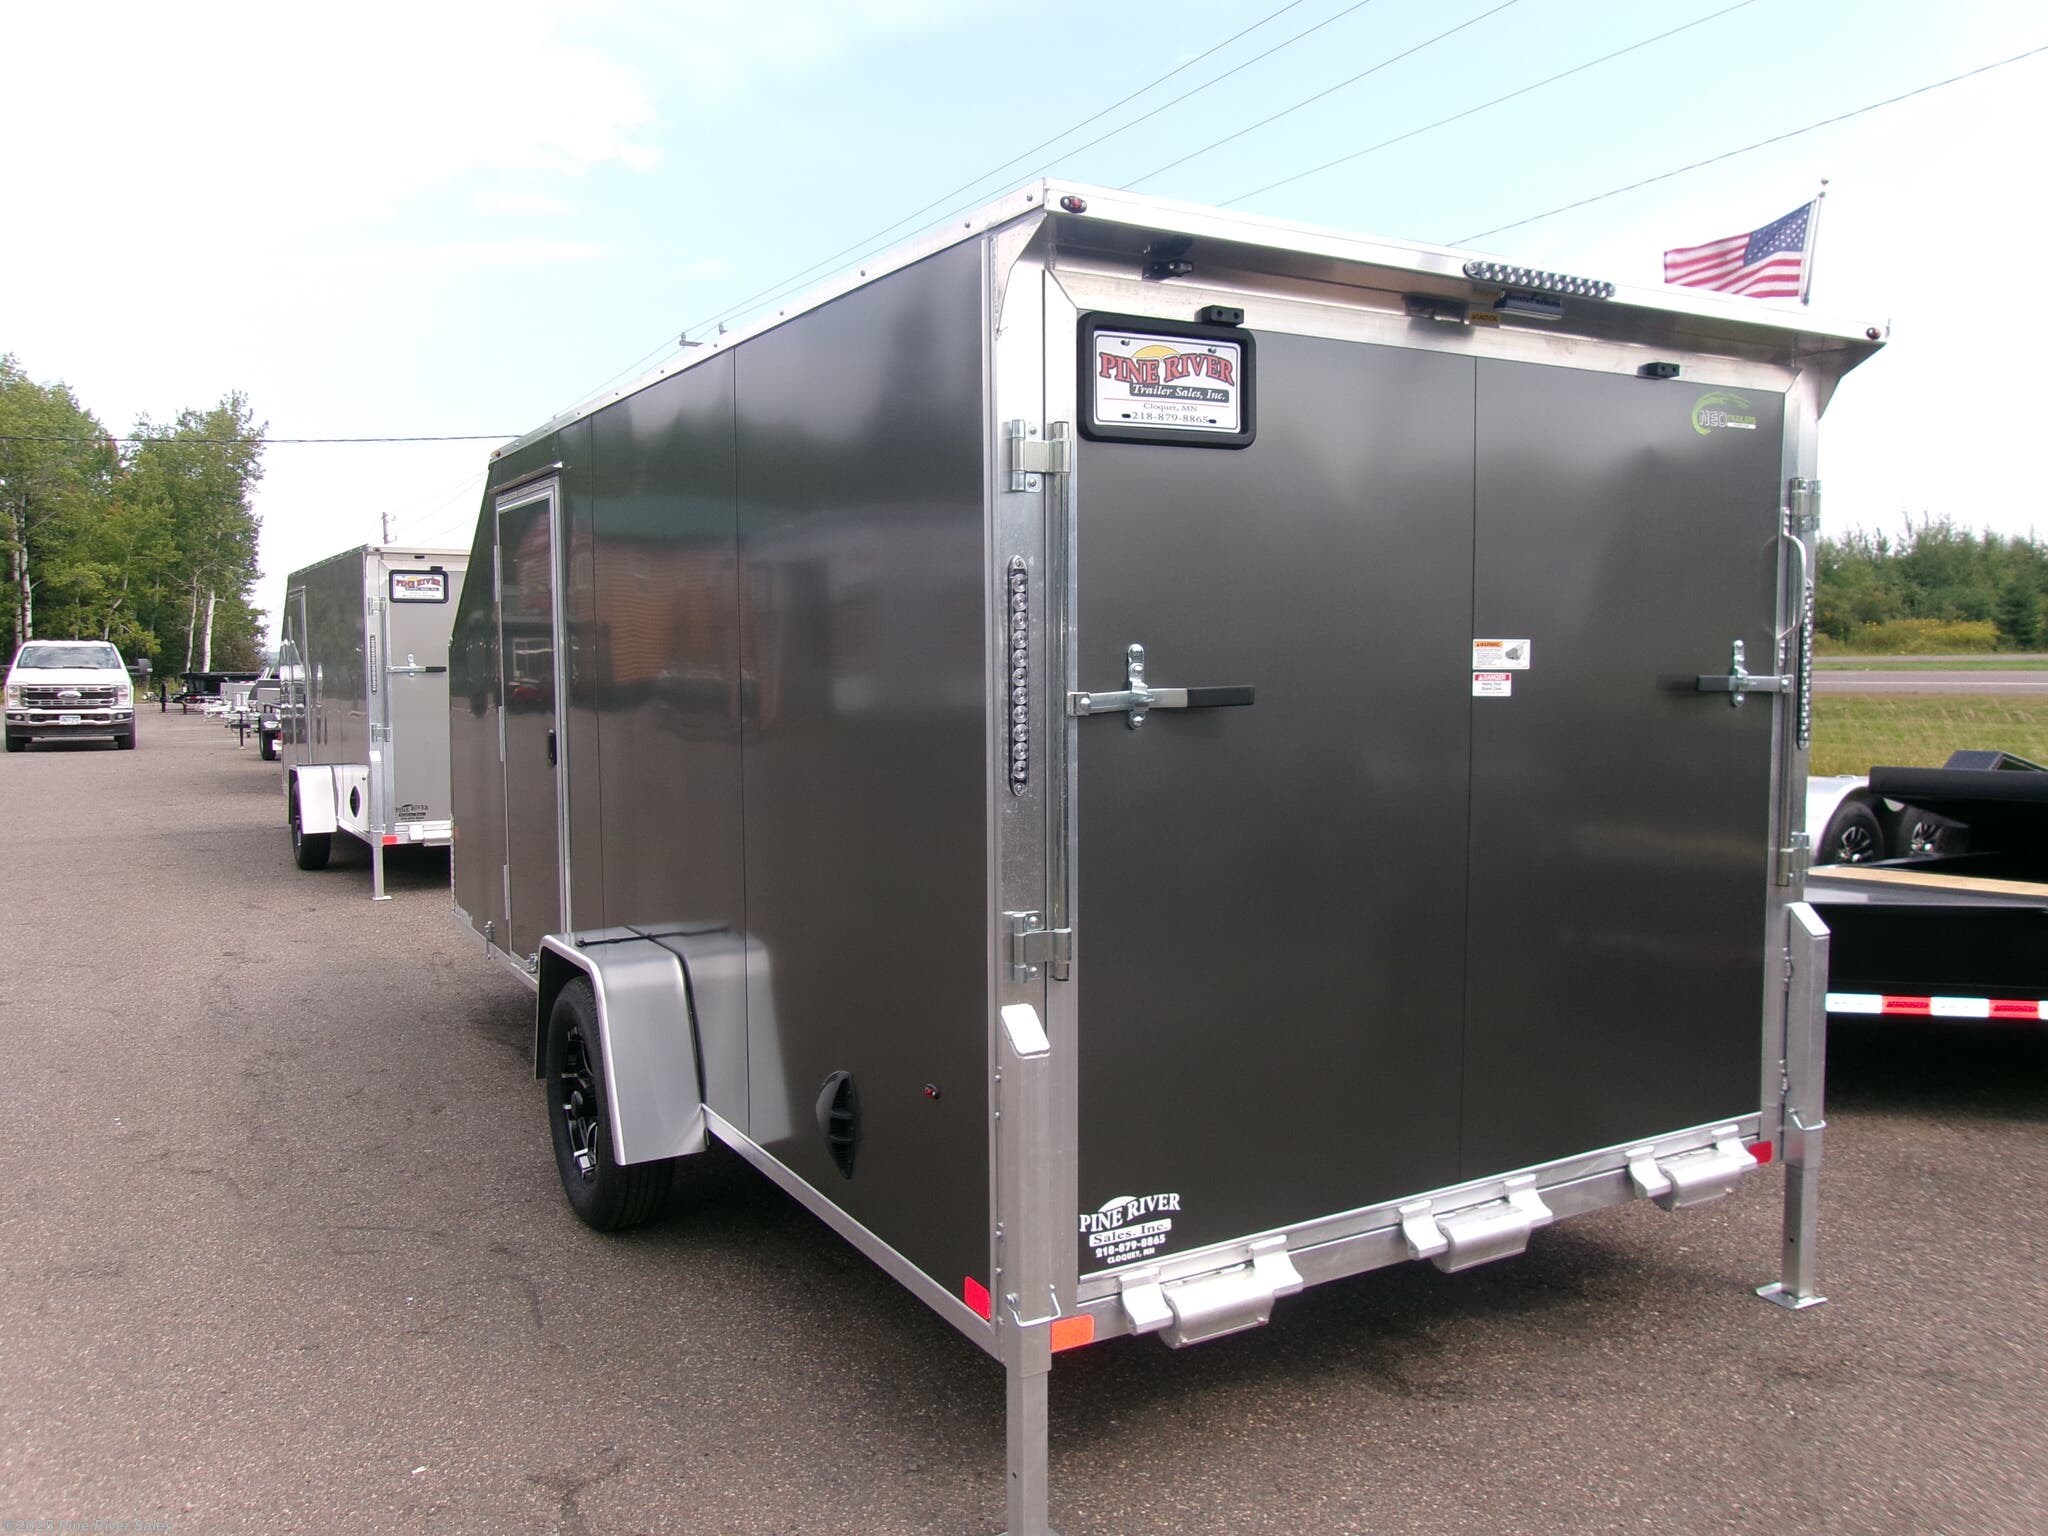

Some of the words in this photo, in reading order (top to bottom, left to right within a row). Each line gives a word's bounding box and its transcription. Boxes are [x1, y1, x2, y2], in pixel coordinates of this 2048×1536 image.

[1099, 352, 1160, 385] PINE
[1164, 353, 1235, 386] RIVER
[1132, 384, 1173, 396] Trailer
[1175, 387, 1204, 399] Sales,
[1206, 389, 1226, 400] Inc.
[1132, 412, 1208, 423] 218-879-8865
[1079, 1206, 1124, 1232] PINE
[1126, 1193, 1181, 1221] RIVER
[1141, 1222, 1168, 1235] Inc.
[1095, 1234, 1166, 1258] 218-879-8865
